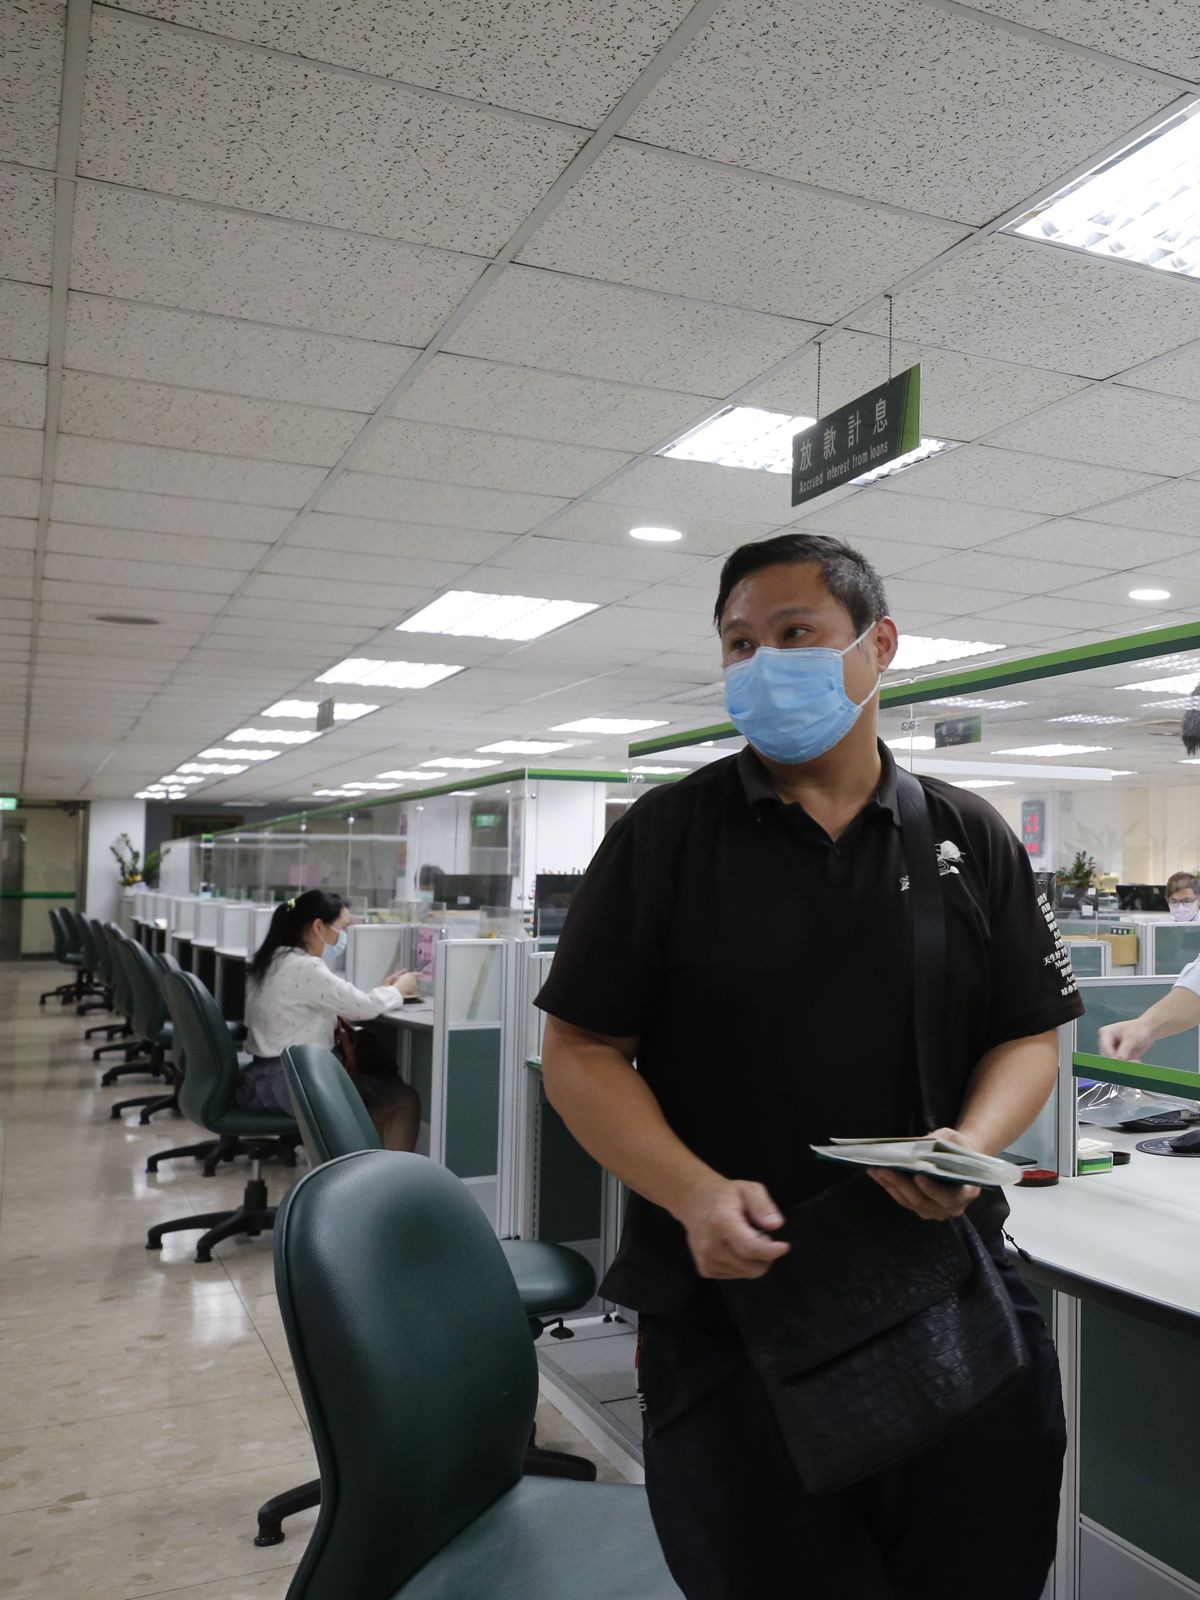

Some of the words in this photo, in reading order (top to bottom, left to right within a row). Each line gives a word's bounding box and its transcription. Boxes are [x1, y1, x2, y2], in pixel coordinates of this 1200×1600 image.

[800, 398, 888, 471] 放款計息
[799, 473, 824, 494] Accrued
[826, 459, 850, 481] interest
[852, 453, 868, 468] from
[870, 440, 888, 457] loans
